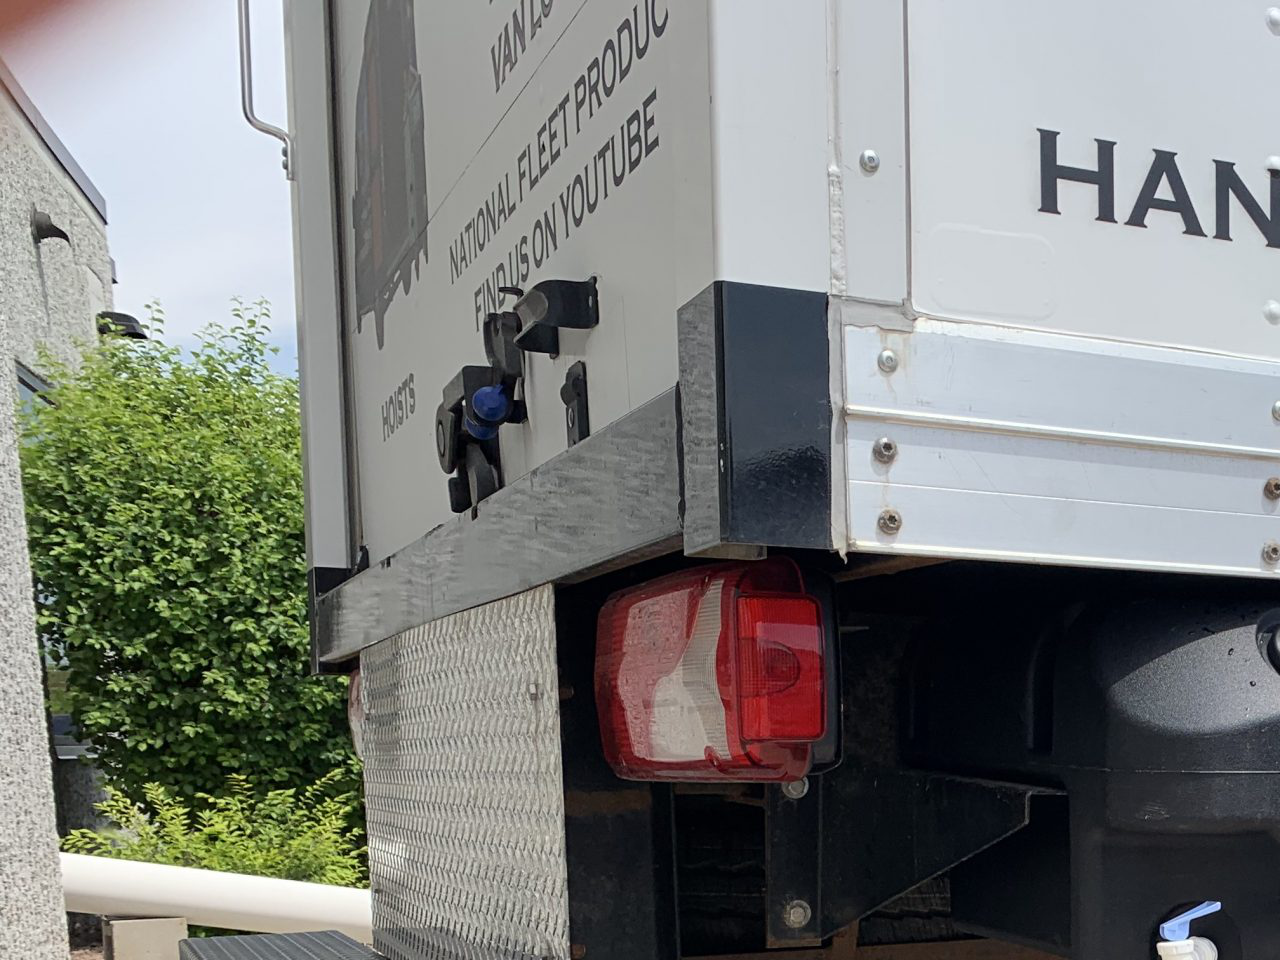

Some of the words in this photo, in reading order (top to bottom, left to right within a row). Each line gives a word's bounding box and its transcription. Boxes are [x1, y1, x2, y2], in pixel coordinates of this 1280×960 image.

[490, 0, 526, 94] VAN
[449, 172, 516, 285] NATIONAL
[517, 90, 570, 203] FLEET
[574, 0, 669, 134] PRODUC
[474, 262, 506, 332] FIND
[508, 235, 530, 289] US
[532, 202, 558, 269] ON
[559, 86, 660, 240] YOUTUBE
[381, 372, 415, 442] HOISTS
